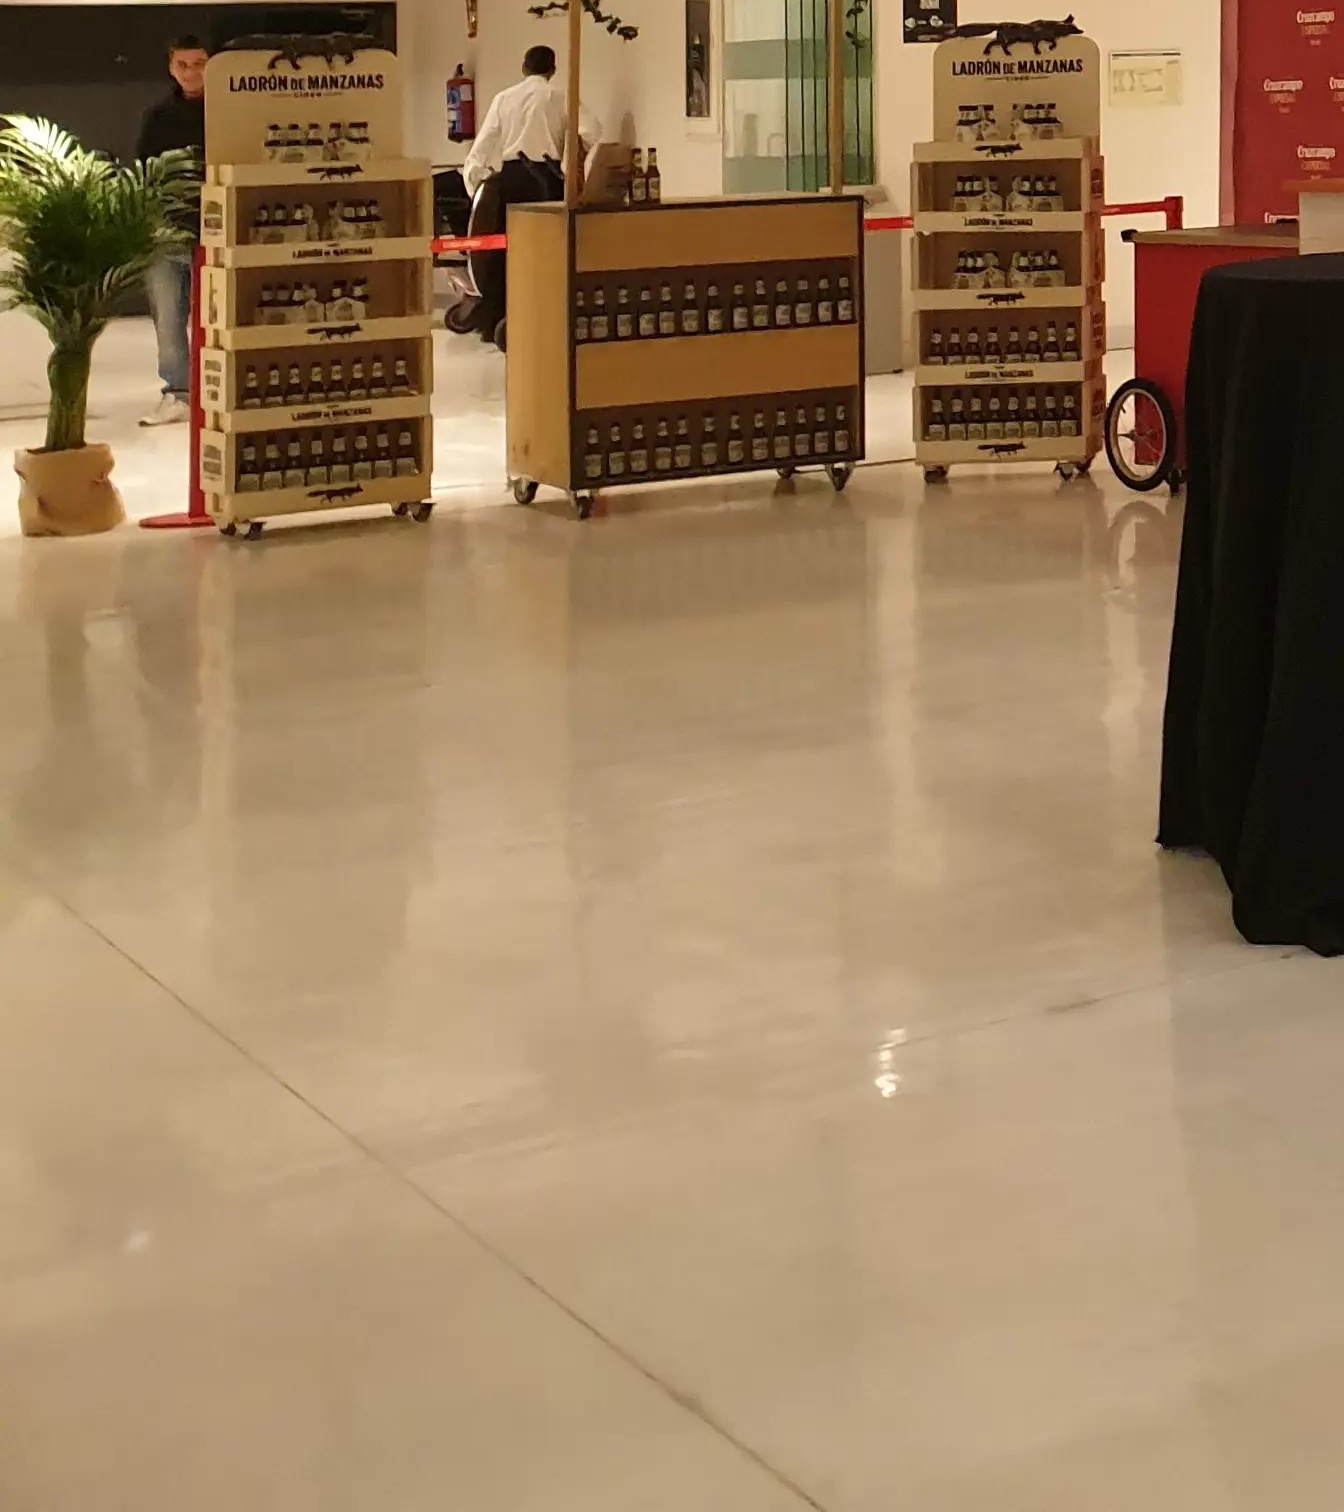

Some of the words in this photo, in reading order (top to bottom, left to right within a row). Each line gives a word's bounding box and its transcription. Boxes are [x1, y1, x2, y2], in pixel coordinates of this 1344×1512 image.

[952, 58, 1001, 76] LADRÓN
[1003, 63, 1016, 74] DE
[1017, 58, 1083, 74] MANZANAS
[229, 72, 288, 92] LADRÓN
[290, 76, 306, 90] DE
[308, 74, 385, 90] MANZANAS
